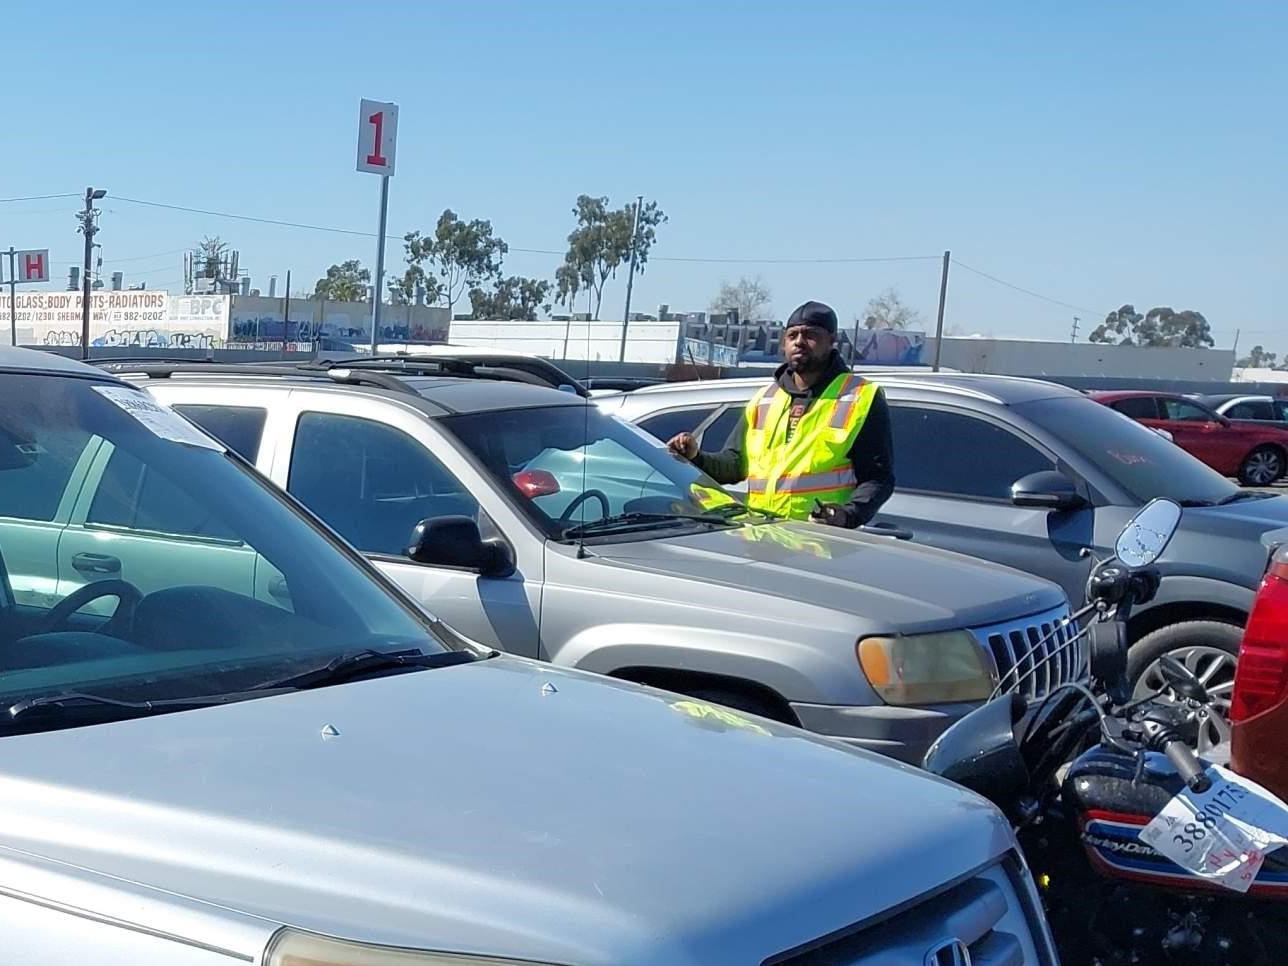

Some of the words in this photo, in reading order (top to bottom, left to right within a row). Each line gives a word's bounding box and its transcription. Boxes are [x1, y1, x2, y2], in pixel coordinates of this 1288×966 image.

[366, 111, 388, 167] 1
[25, 254, 44, 280] H
[57, 311, 86, 321] SHERMA
[123, 311, 163, 321] 982-0202
[191, 299, 223, 315] BPC
